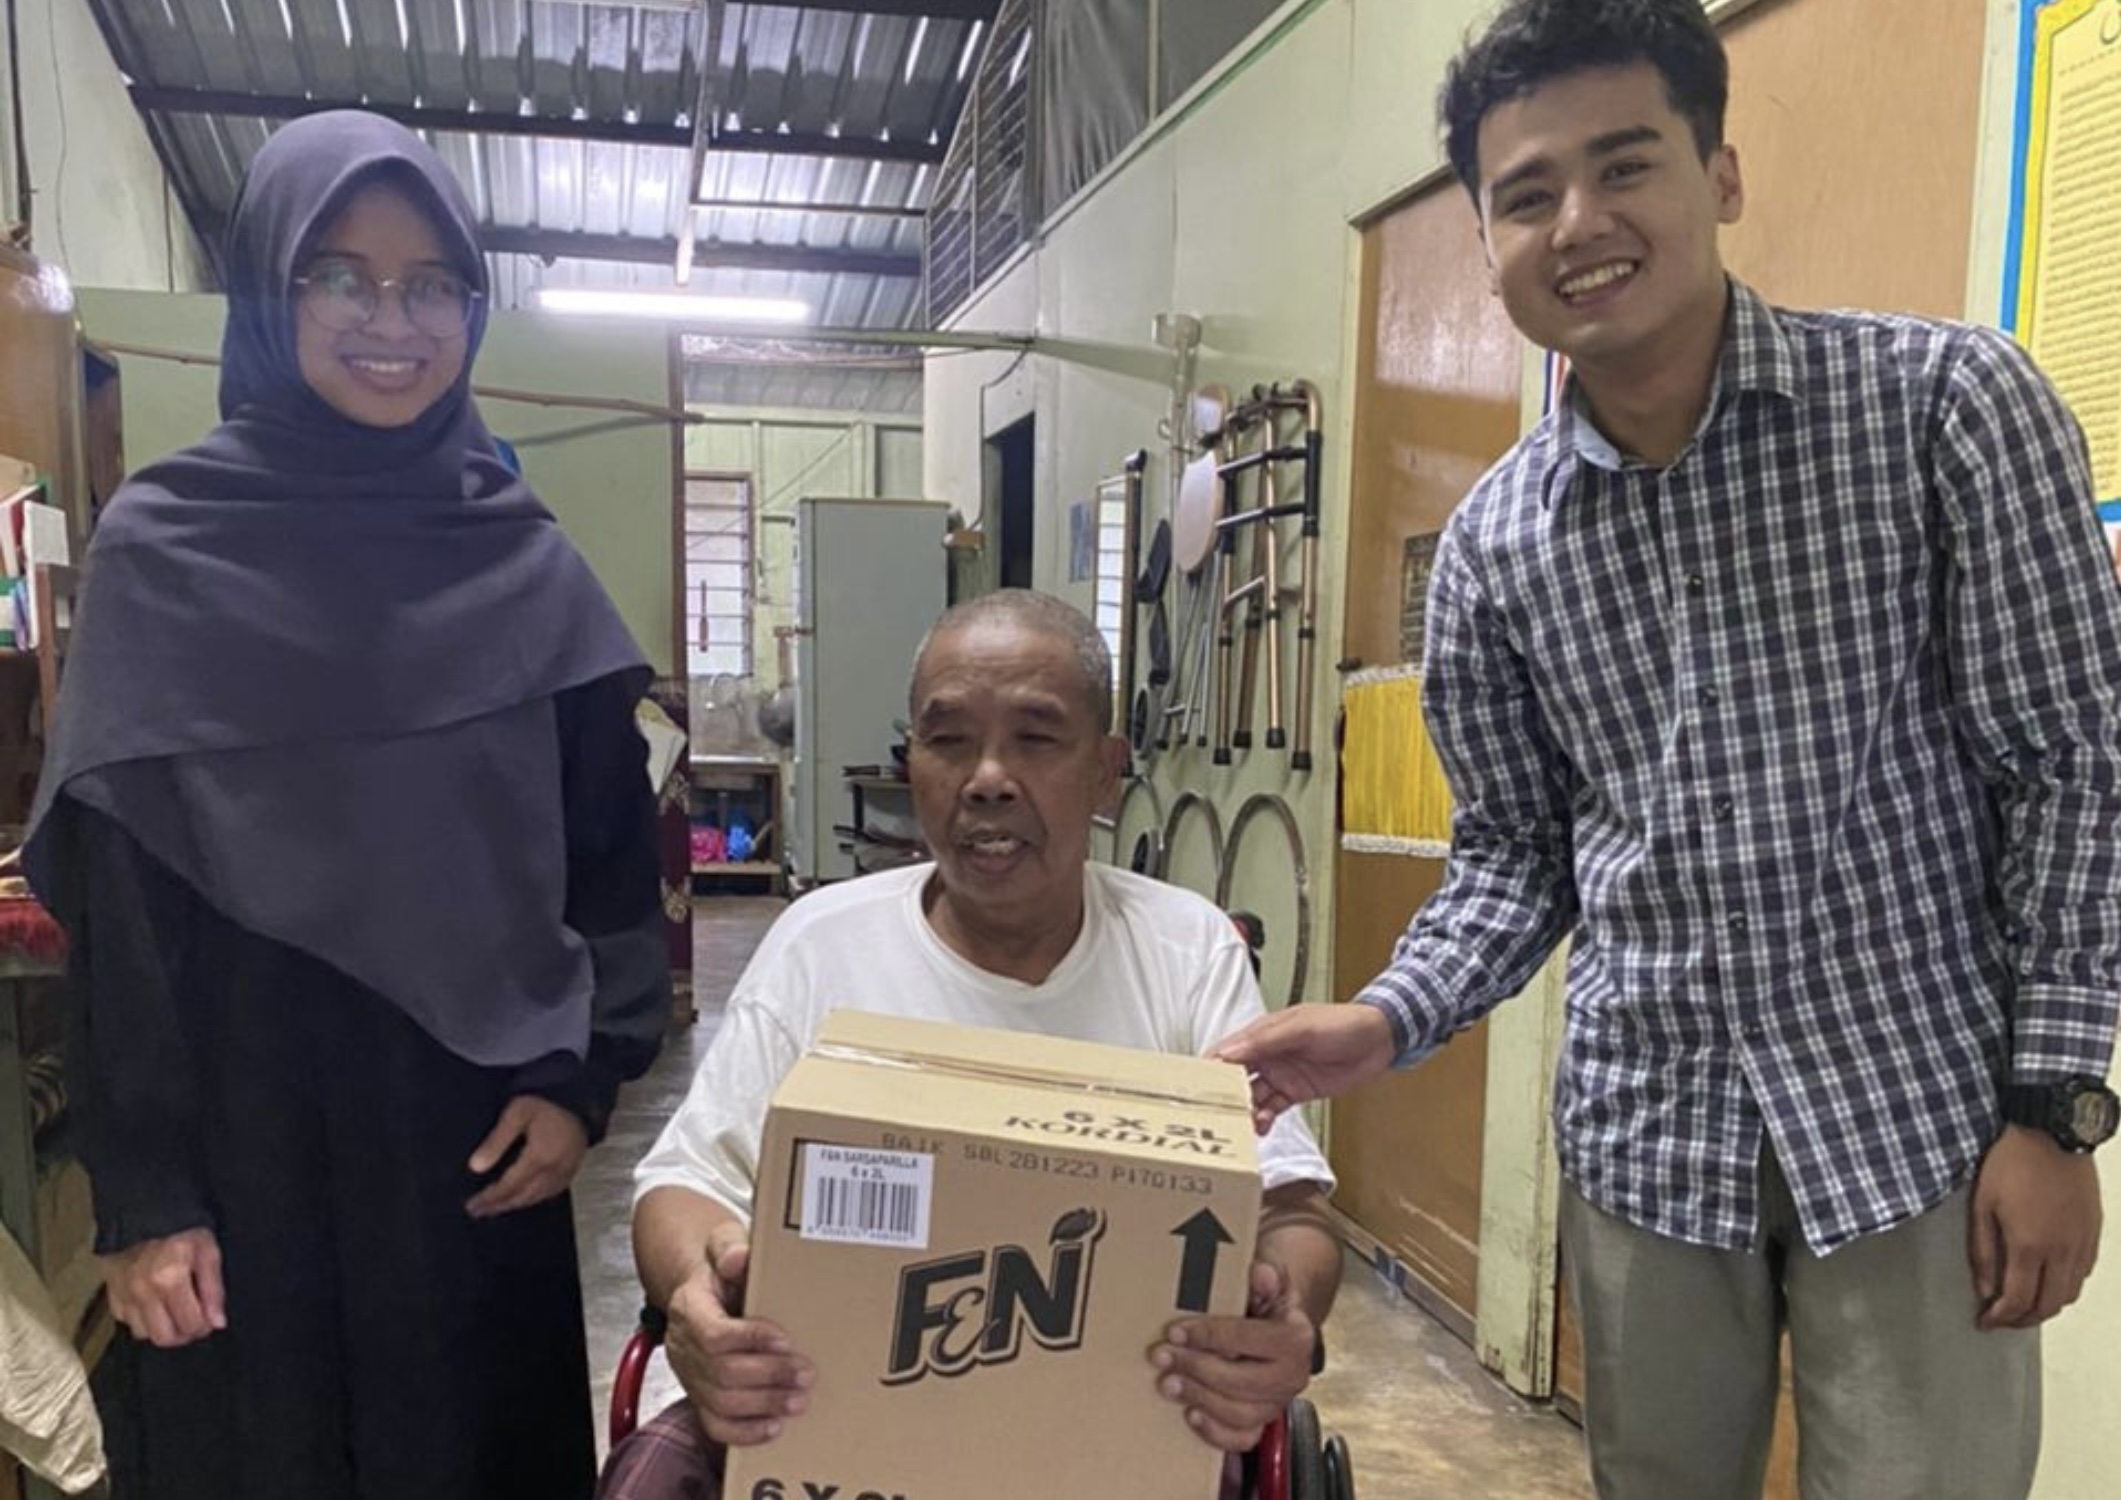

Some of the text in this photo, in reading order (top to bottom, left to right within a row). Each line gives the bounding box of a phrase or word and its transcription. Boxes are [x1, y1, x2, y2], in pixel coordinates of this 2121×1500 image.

[1004, 1115, 1237, 1159] KORDIAL
[1063, 1110, 1233, 1144] 6 X 2L
